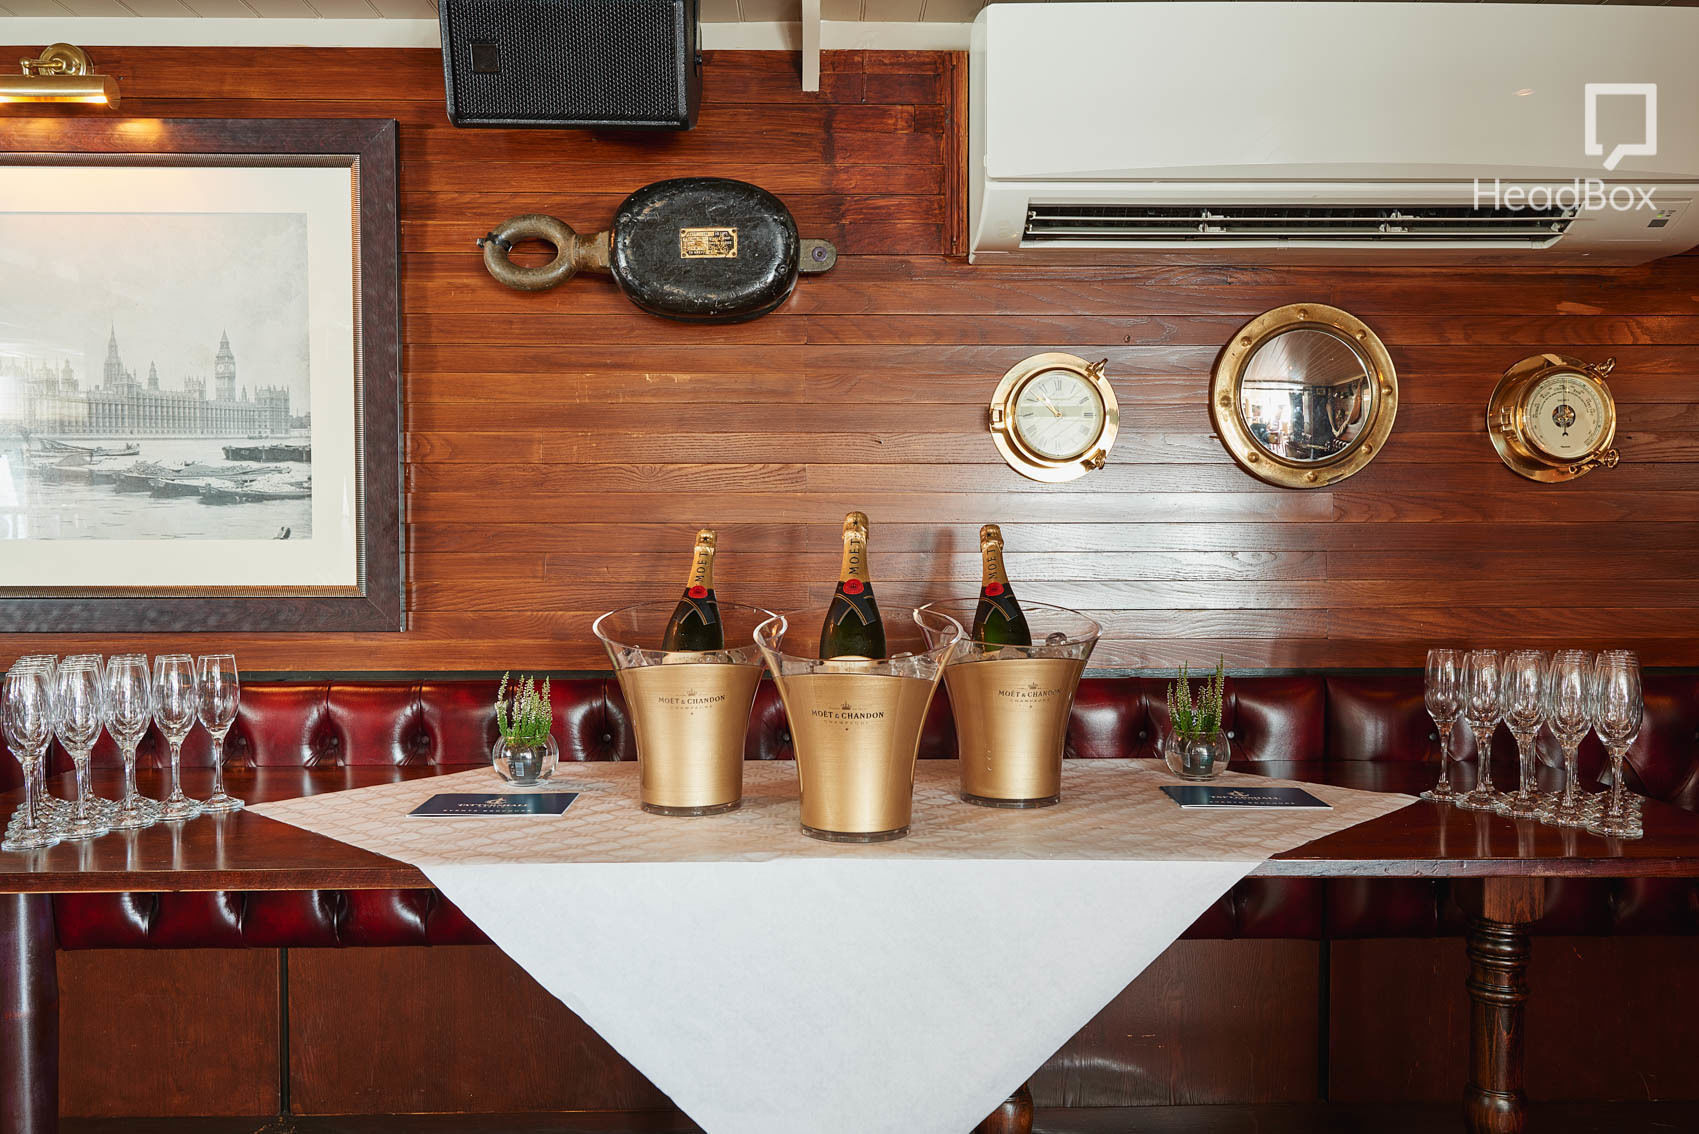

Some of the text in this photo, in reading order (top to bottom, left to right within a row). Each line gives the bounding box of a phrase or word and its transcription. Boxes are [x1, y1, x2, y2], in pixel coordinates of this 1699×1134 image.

[1027, 689, 1061, 697] CHANDON
[687, 694, 726, 705] CHANDON
[841, 711, 885, 720] CHANDON
